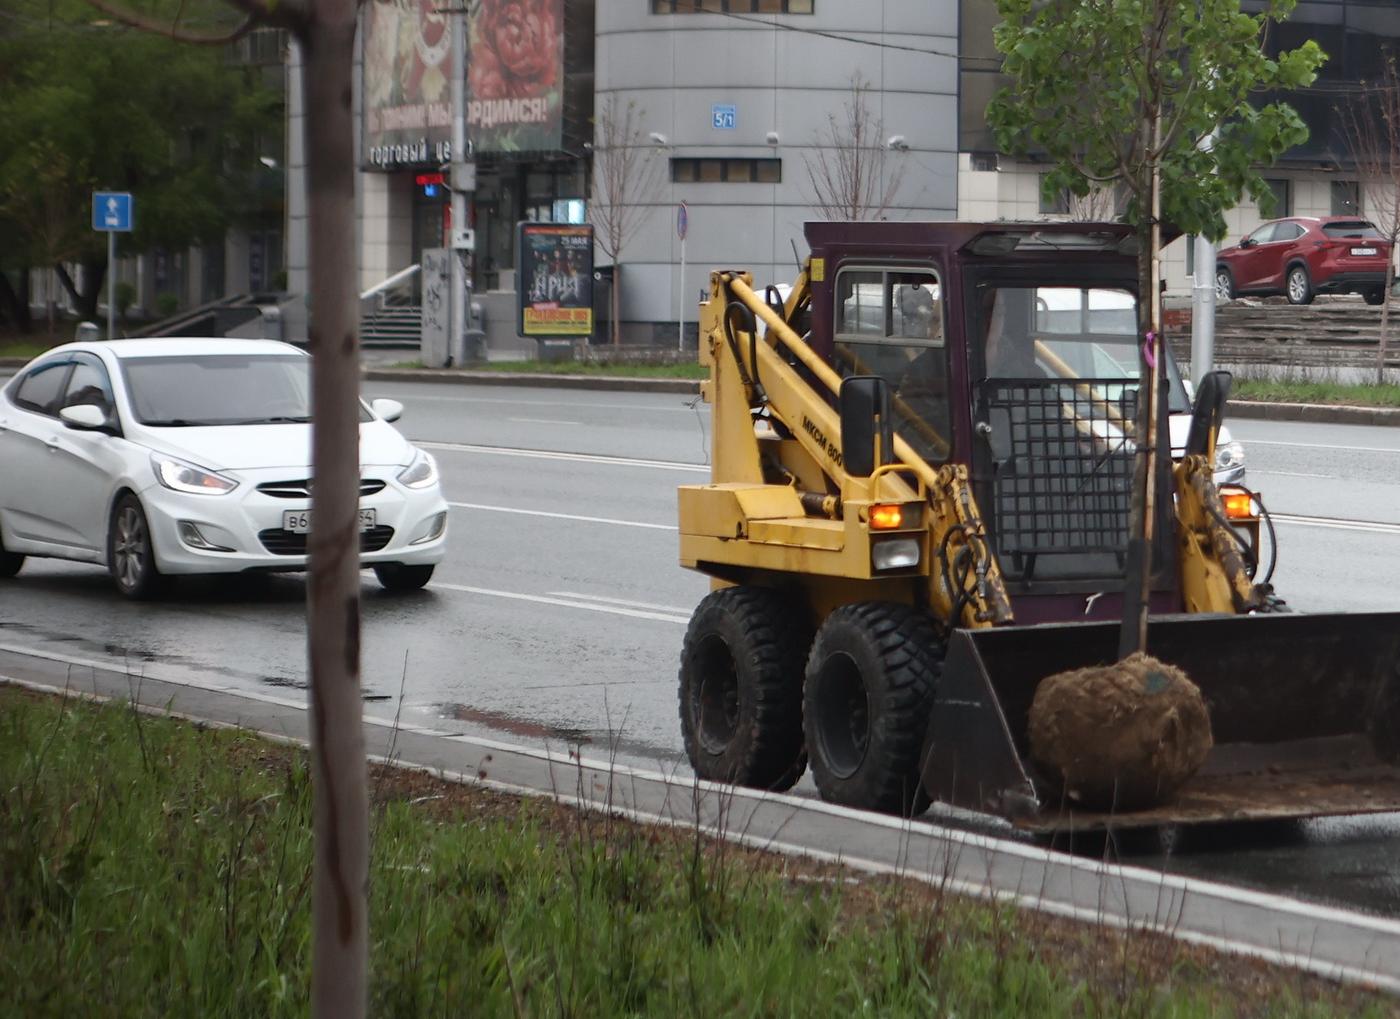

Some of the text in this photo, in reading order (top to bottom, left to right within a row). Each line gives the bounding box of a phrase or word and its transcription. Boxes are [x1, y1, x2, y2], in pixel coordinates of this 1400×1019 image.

[467, 98, 548, 128] РДИМСЯ!
[370, 137, 427, 169] торговый
[802, 415, 843, 467] МКСМ 800
